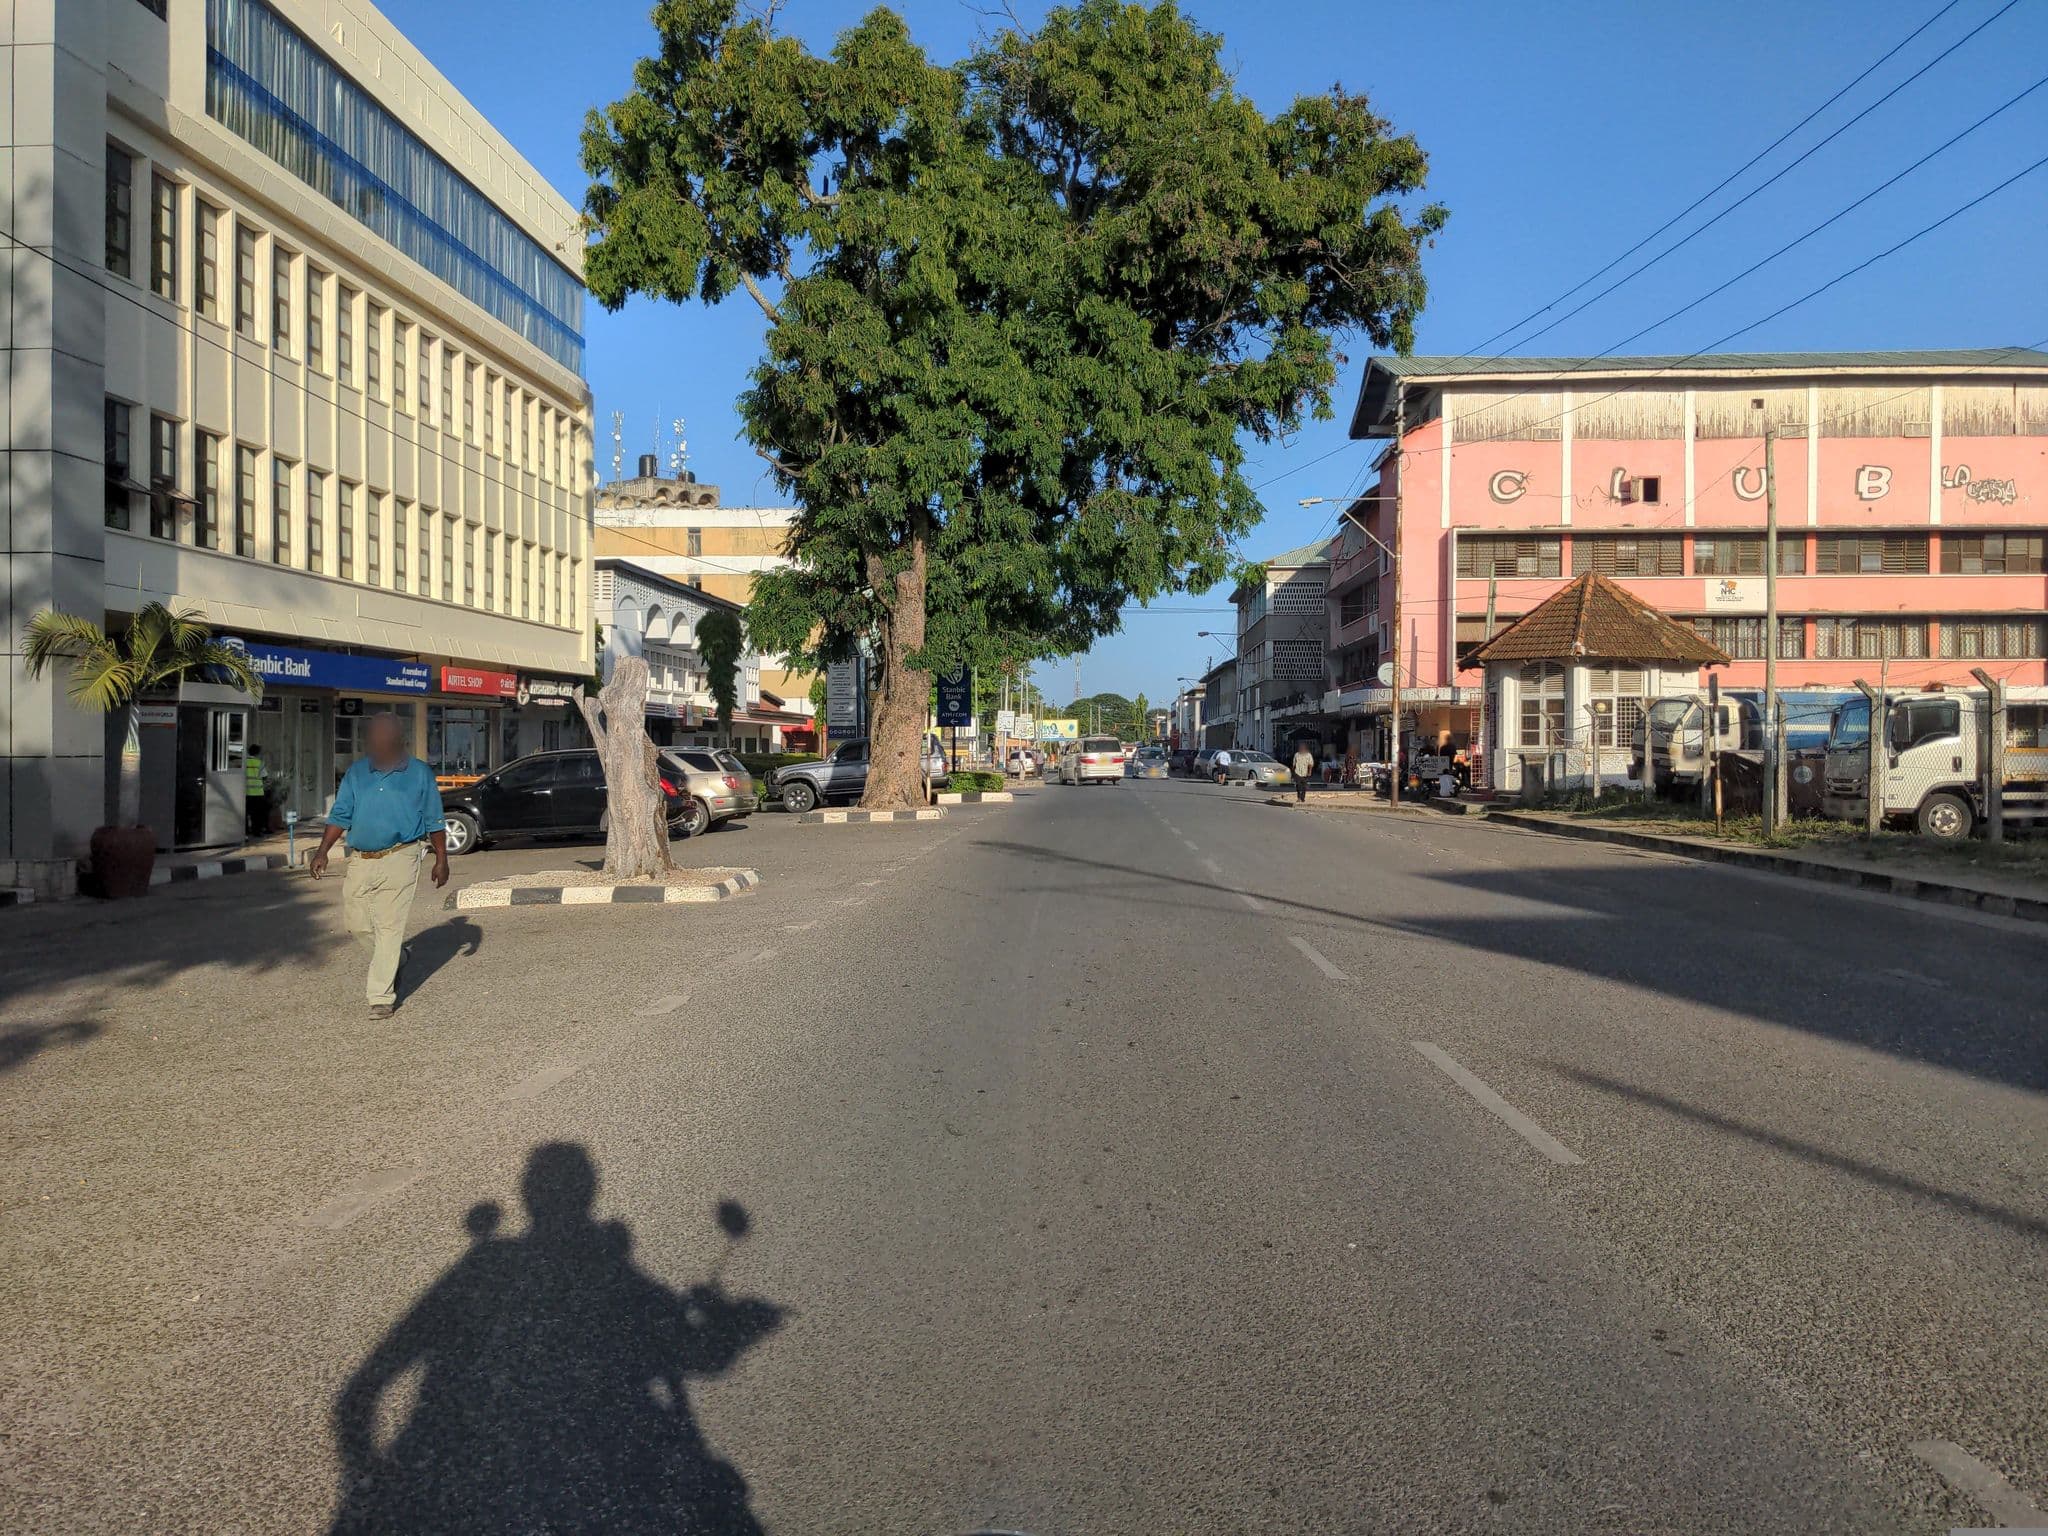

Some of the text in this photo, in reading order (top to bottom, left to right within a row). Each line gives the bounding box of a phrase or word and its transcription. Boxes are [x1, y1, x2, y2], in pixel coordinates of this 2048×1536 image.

[246, 654, 311, 677] tanbic Bank
[447, 675, 483, 688] AIRTEL SHOP
